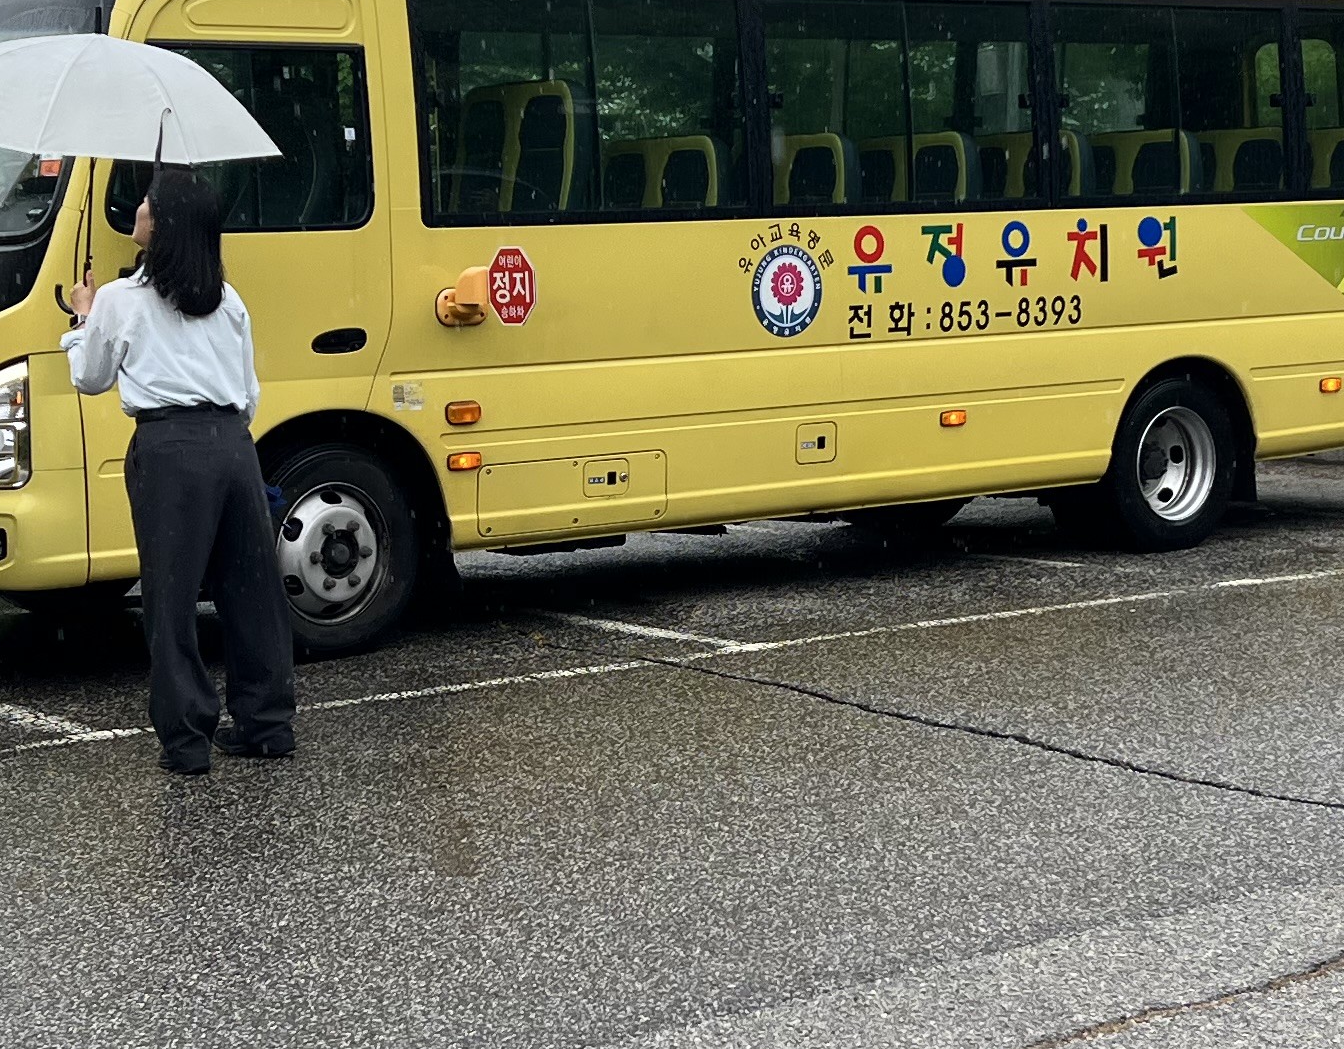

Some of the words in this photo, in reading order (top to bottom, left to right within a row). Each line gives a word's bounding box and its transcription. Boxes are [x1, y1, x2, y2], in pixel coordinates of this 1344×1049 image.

[498, 255, 522, 268] 어린이
[847, 216, 1178, 294] 유정유치원
[492, 270, 531, 304] 정지
